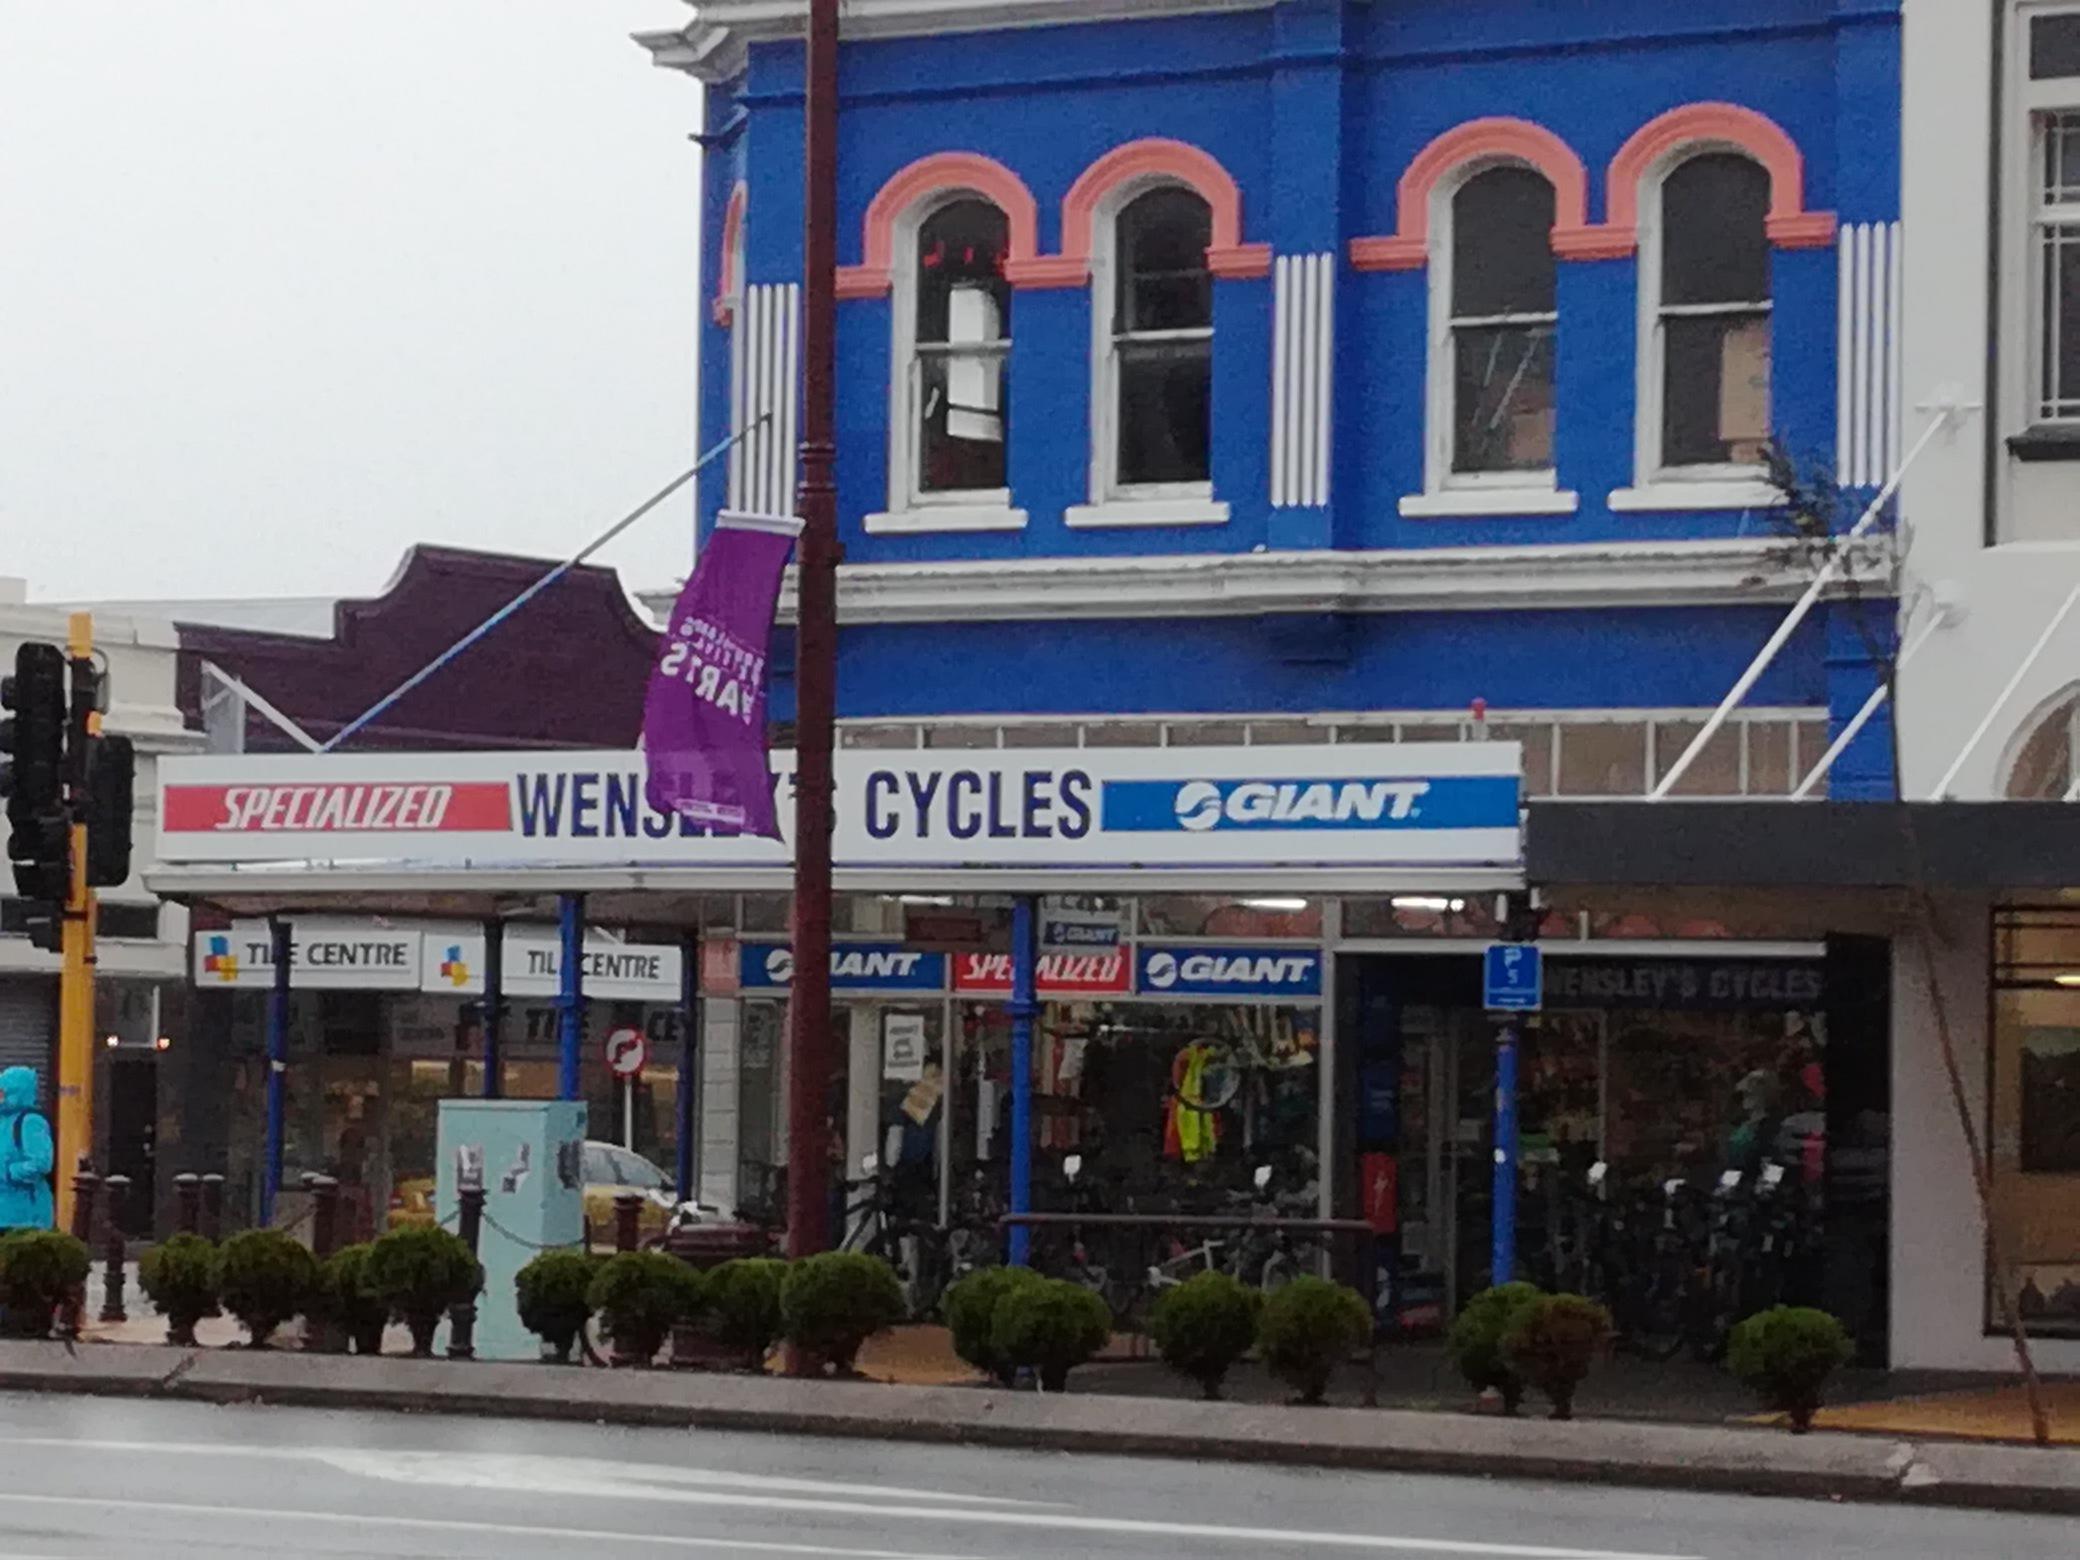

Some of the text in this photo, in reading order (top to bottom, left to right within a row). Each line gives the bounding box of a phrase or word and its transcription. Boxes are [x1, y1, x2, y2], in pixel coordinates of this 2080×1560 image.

[215, 784, 452, 830] SPECIALIZED
[865, 769, 1092, 839] CYCLES
[1225, 782, 1431, 822] GIANT
[246, 942, 409, 967] TIE CENTRE
[527, 950, 564, 975] TIL
[830, 952, 922, 977] IANT
[963, 953, 1122, 983] SPEALIZED
[1180, 955, 1316, 983] GIANT
[1504, 947, 1523, 967] P
[1709, 968, 1824, 1001] CYCLES
